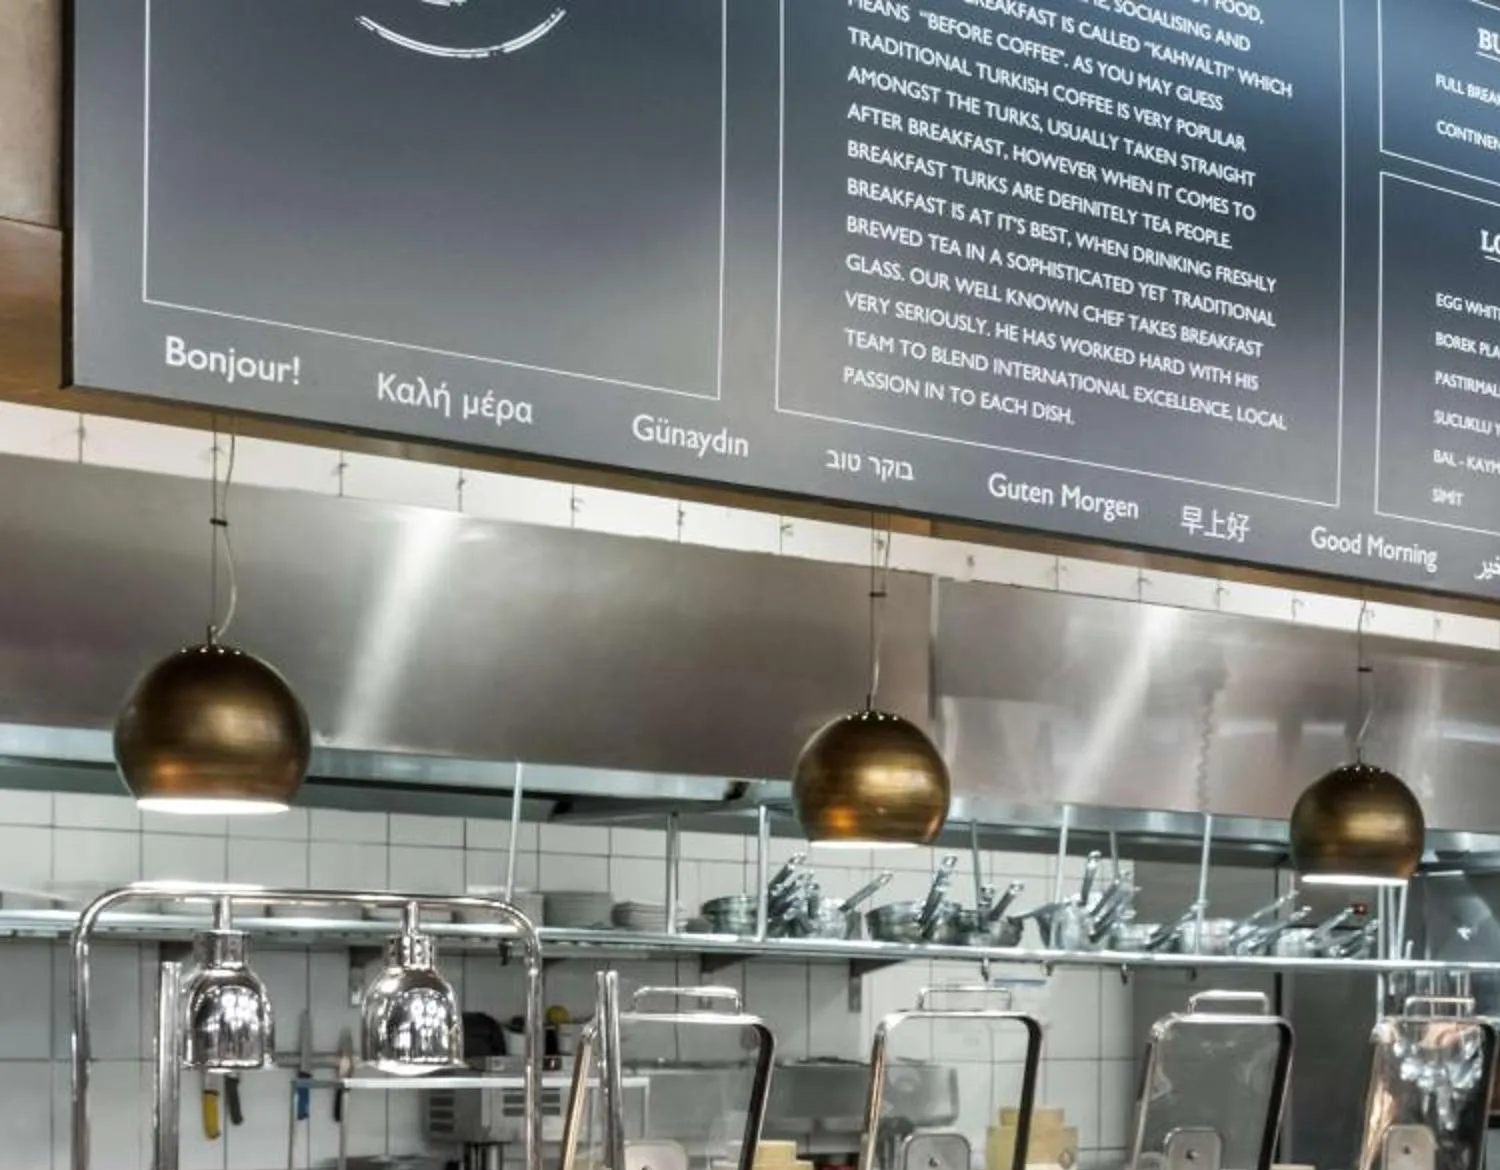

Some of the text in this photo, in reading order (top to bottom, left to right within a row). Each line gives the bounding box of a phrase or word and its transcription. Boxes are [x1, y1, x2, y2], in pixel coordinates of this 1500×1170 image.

[1061, 17, 1075, 33] IS
[1078, 22, 1140, 52] CALLED
[1237, 68, 1293, 97] WHICH
[1214, 29, 1250, 51] AND
[847, 26, 1247, 150] TRADITIONAL TURKISH COFFEE IS VERY POPULAR
[1072, 55, 1093, 74] AS
[1097, 60, 1134, 85] YOU
[1137, 72, 1173, 96] MAY
[1175, 84, 1223, 110] GUESS
[1435, 73, 1465, 95] FULL
[847, 66, 1256, 186] AMONGST THE TURKS, USUALLY TAKEN STRAIGHT
[847, 103, 903, 131] AFTER
[1012, 145, 1098, 180] HOWEVER
[1101, 167, 1152, 194] WHEN
[1156, 181, 1173, 199] IT
[1175, 187, 1229, 214] COMES
[1231, 200, 1256, 220] TO
[847, 139, 948, 177] BREAKFAST
[951, 165, 1007, 194] TURKS
[1011, 181, 1044, 203] ARE
[1049, 189, 1139, 224] DEFINITELY
[1141, 212, 1172, 234] TEA
[847, 177, 947, 214] BREAKFAST
[951, 202, 965, 220] IS
[968, 207, 994, 226] AT
[1029, 220, 1071, 247] BEST,
[1075, 232, 1129, 258] WHEN
[1132, 245, 1211, 278] DRINKING
[1215, 265, 1276, 292] FRESHLY
[846, 215, 1277, 326] BREWED TEA IN A SOPHISTICATED YET TRADITIONAL
[845, 253, 1264, 356] GLASS. OUR WELL KNOWN CHEF TAKES BREAKFAST
[1435, 292, 1462, 311] EGG
[165, 335, 302, 386] Bonjour!
[844, 290, 1259, 390] VERY SERIOUSLY. HE HAS WORKED HARD WITH HIS
[378, 372, 532, 425] Καλή μέρα
[843, 366, 1075, 424] PASSION IN TO EACH DISH.
[845, 327, 894, 352] TEAM
[899, 338, 927, 359] TO
[931, 345, 988, 371] BLEND
[993, 358, 1129, 399] INTERNATIONAL
[1236, 406, 1287, 430] LOCAL
[1433, 409, 1492, 434] SUCUKLU
[826, 450, 913, 481] בוקר טוב
[1433, 449, 1456, 466] BAL
[988, 473, 1138, 522] Guten Morgen
[1182, 506, 1249, 542] 早上好
[1311, 526, 1437, 572] Good Morning
